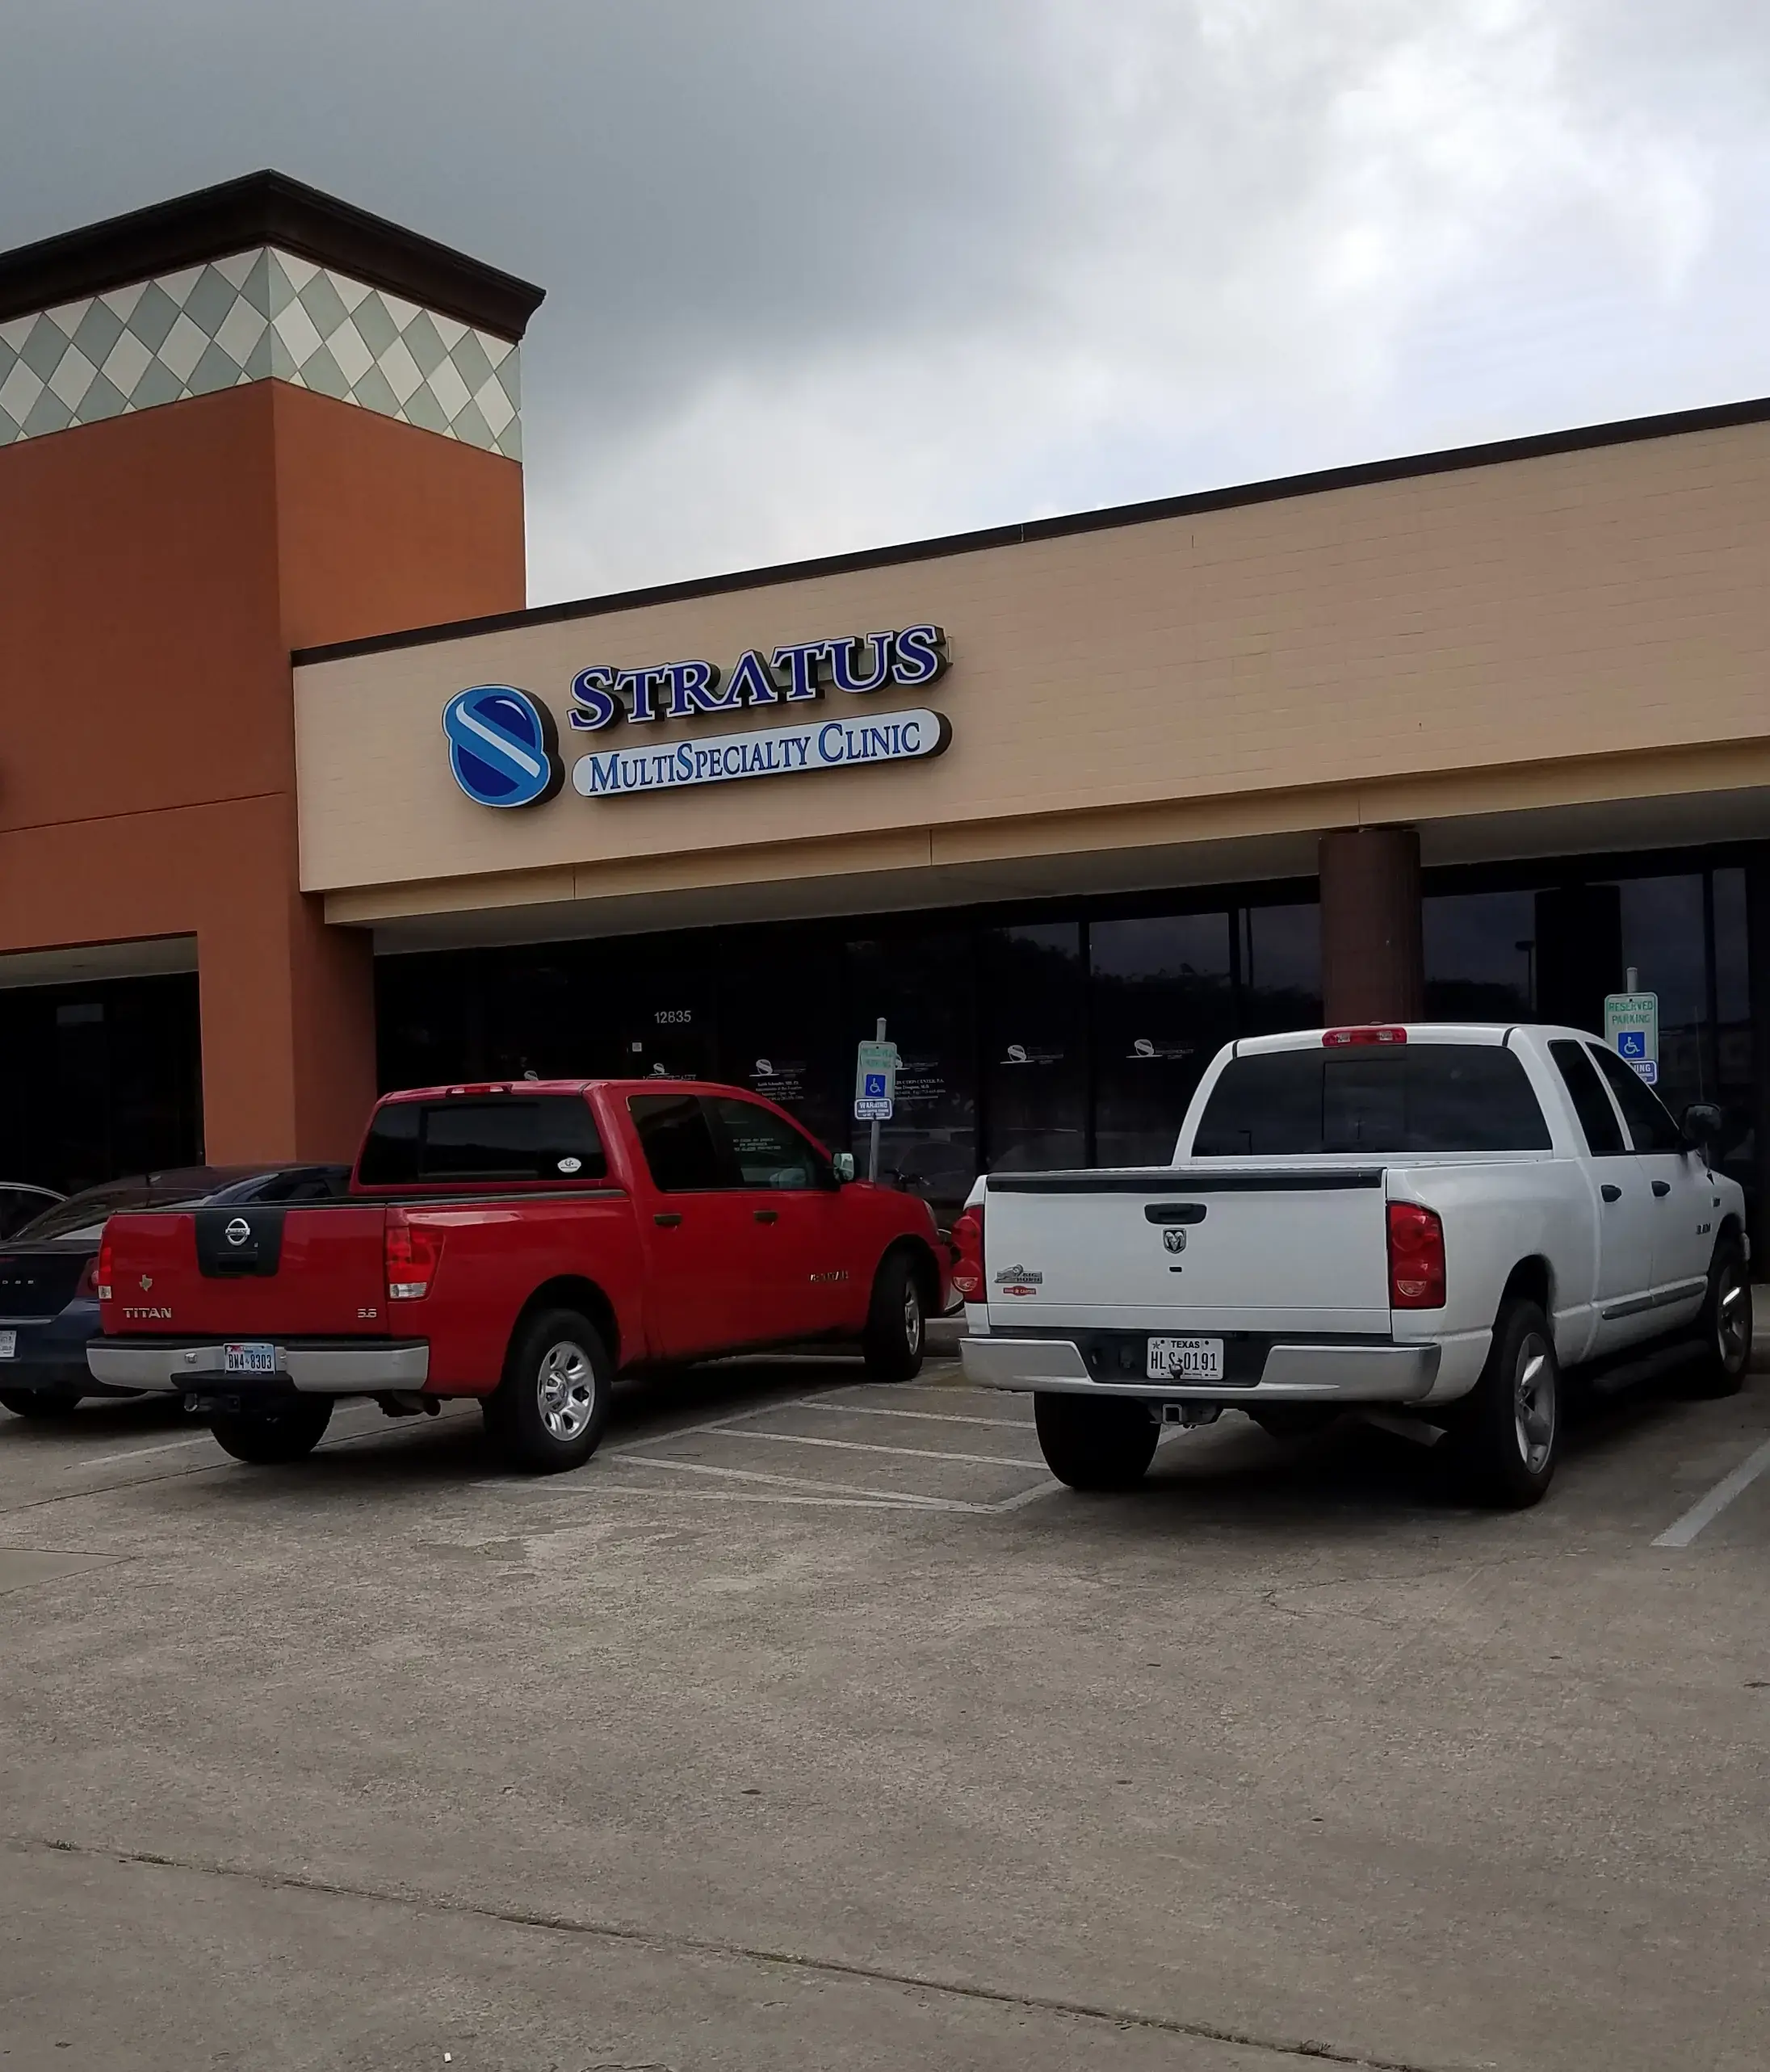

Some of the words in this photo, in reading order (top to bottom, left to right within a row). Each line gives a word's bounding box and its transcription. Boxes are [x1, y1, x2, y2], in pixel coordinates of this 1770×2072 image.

[568, 624, 940, 732] STRATUS
[589, 736, 812, 793] MULTISPECIALTY
[818, 722, 921, 764] CLINIC
[1609, 1000, 1653, 1012] RESERVED
[653, 1009, 692, 1024] 12835
[1612, 1014, 1650, 1025] PARKING
[122, 1307, 172, 1319] TITAN
[1170, 1340, 1201, 1348] TEXAS
